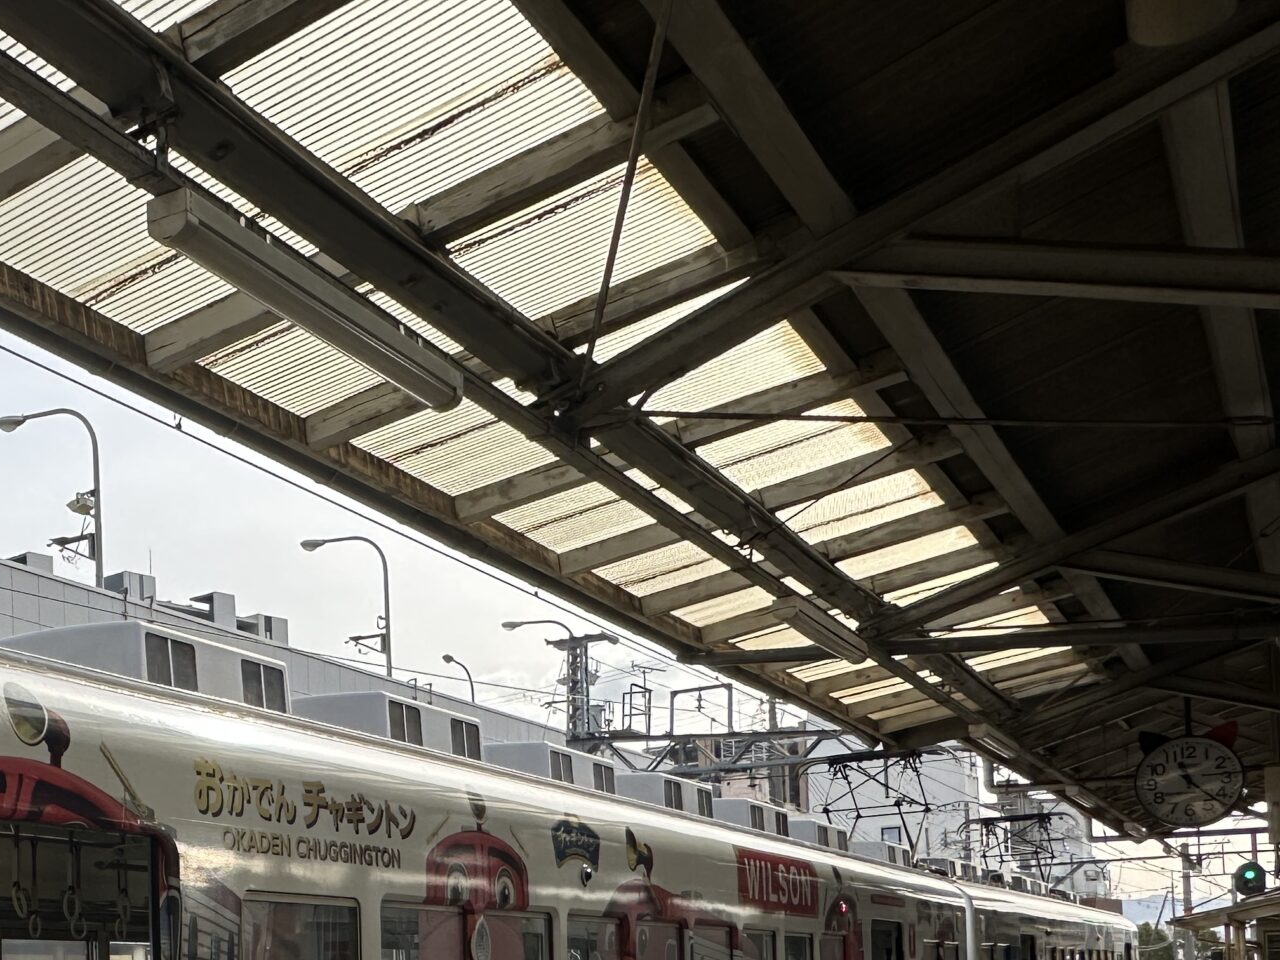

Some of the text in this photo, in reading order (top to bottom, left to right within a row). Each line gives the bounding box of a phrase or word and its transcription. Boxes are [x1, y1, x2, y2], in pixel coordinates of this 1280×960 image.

[193, 756, 417, 841] おかでん チャギントン
[223, 827, 401, 869] OKADEN CHUGGINGTON
[744, 857, 812, 907] WILSON
